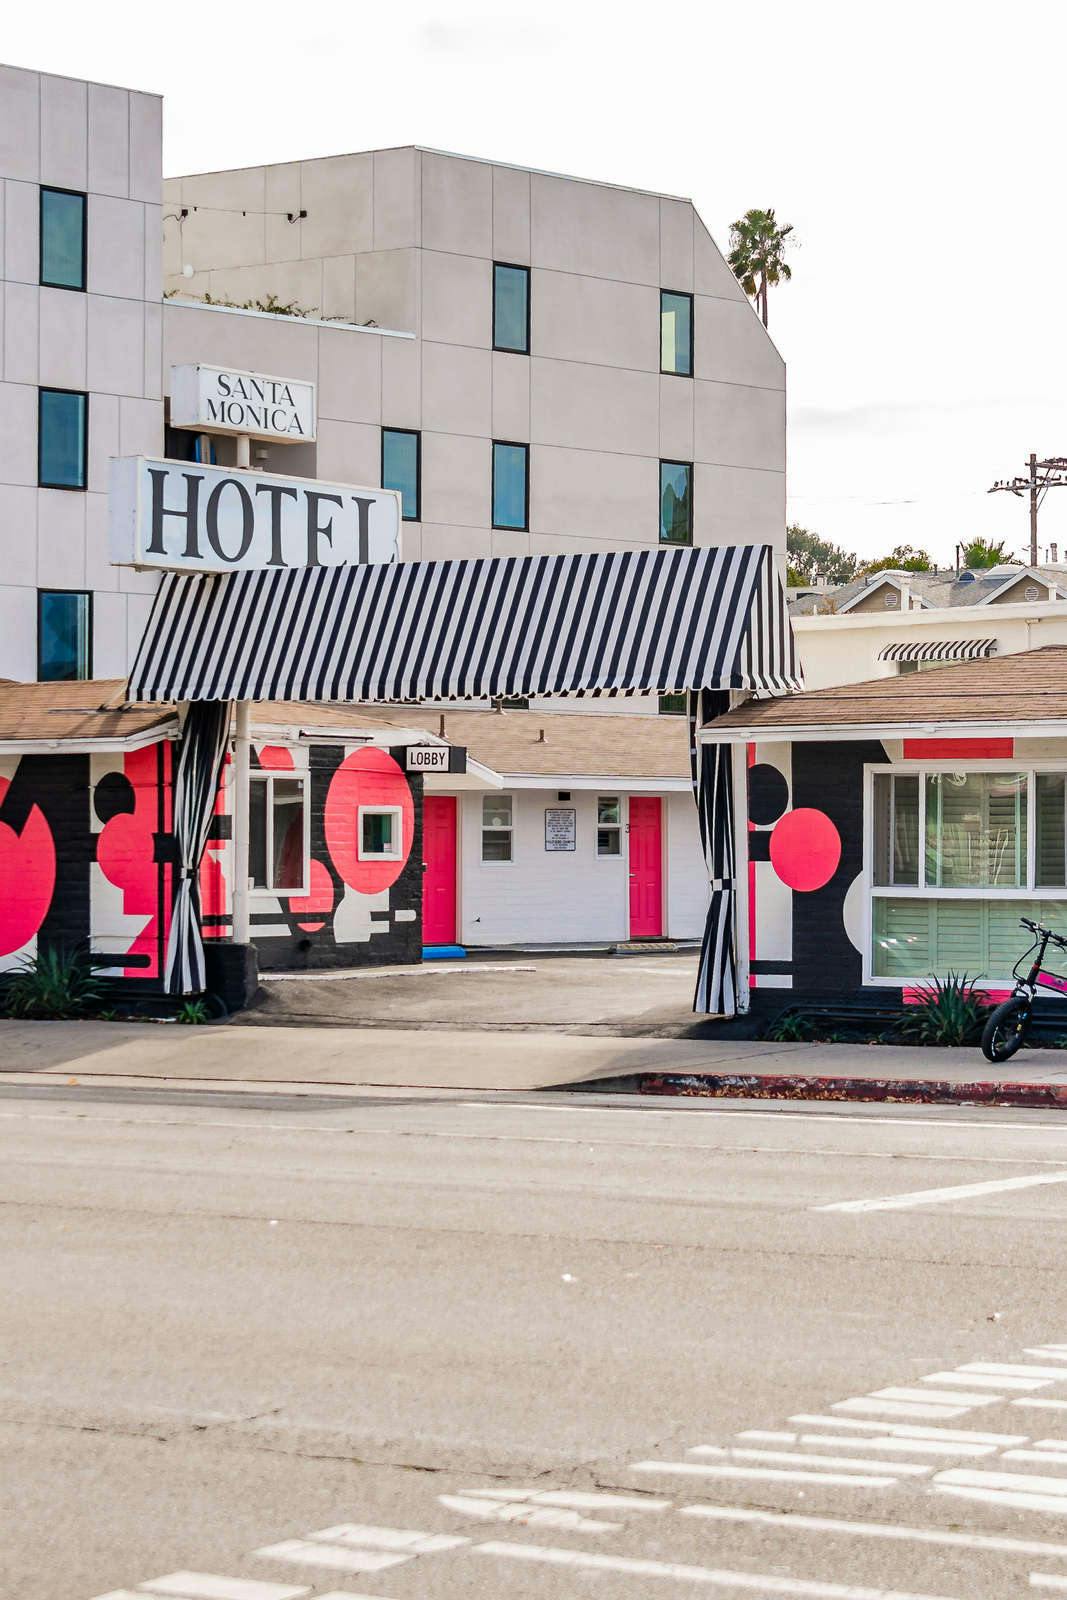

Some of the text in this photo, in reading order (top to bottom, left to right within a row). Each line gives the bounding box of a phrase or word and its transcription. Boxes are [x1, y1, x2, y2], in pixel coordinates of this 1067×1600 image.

[217, 374, 295, 407] SANTA
[207, 398, 304, 435] MONICA
[146, 468, 395, 568] HOTEL
[410, 751, 446, 766] LOBBY
